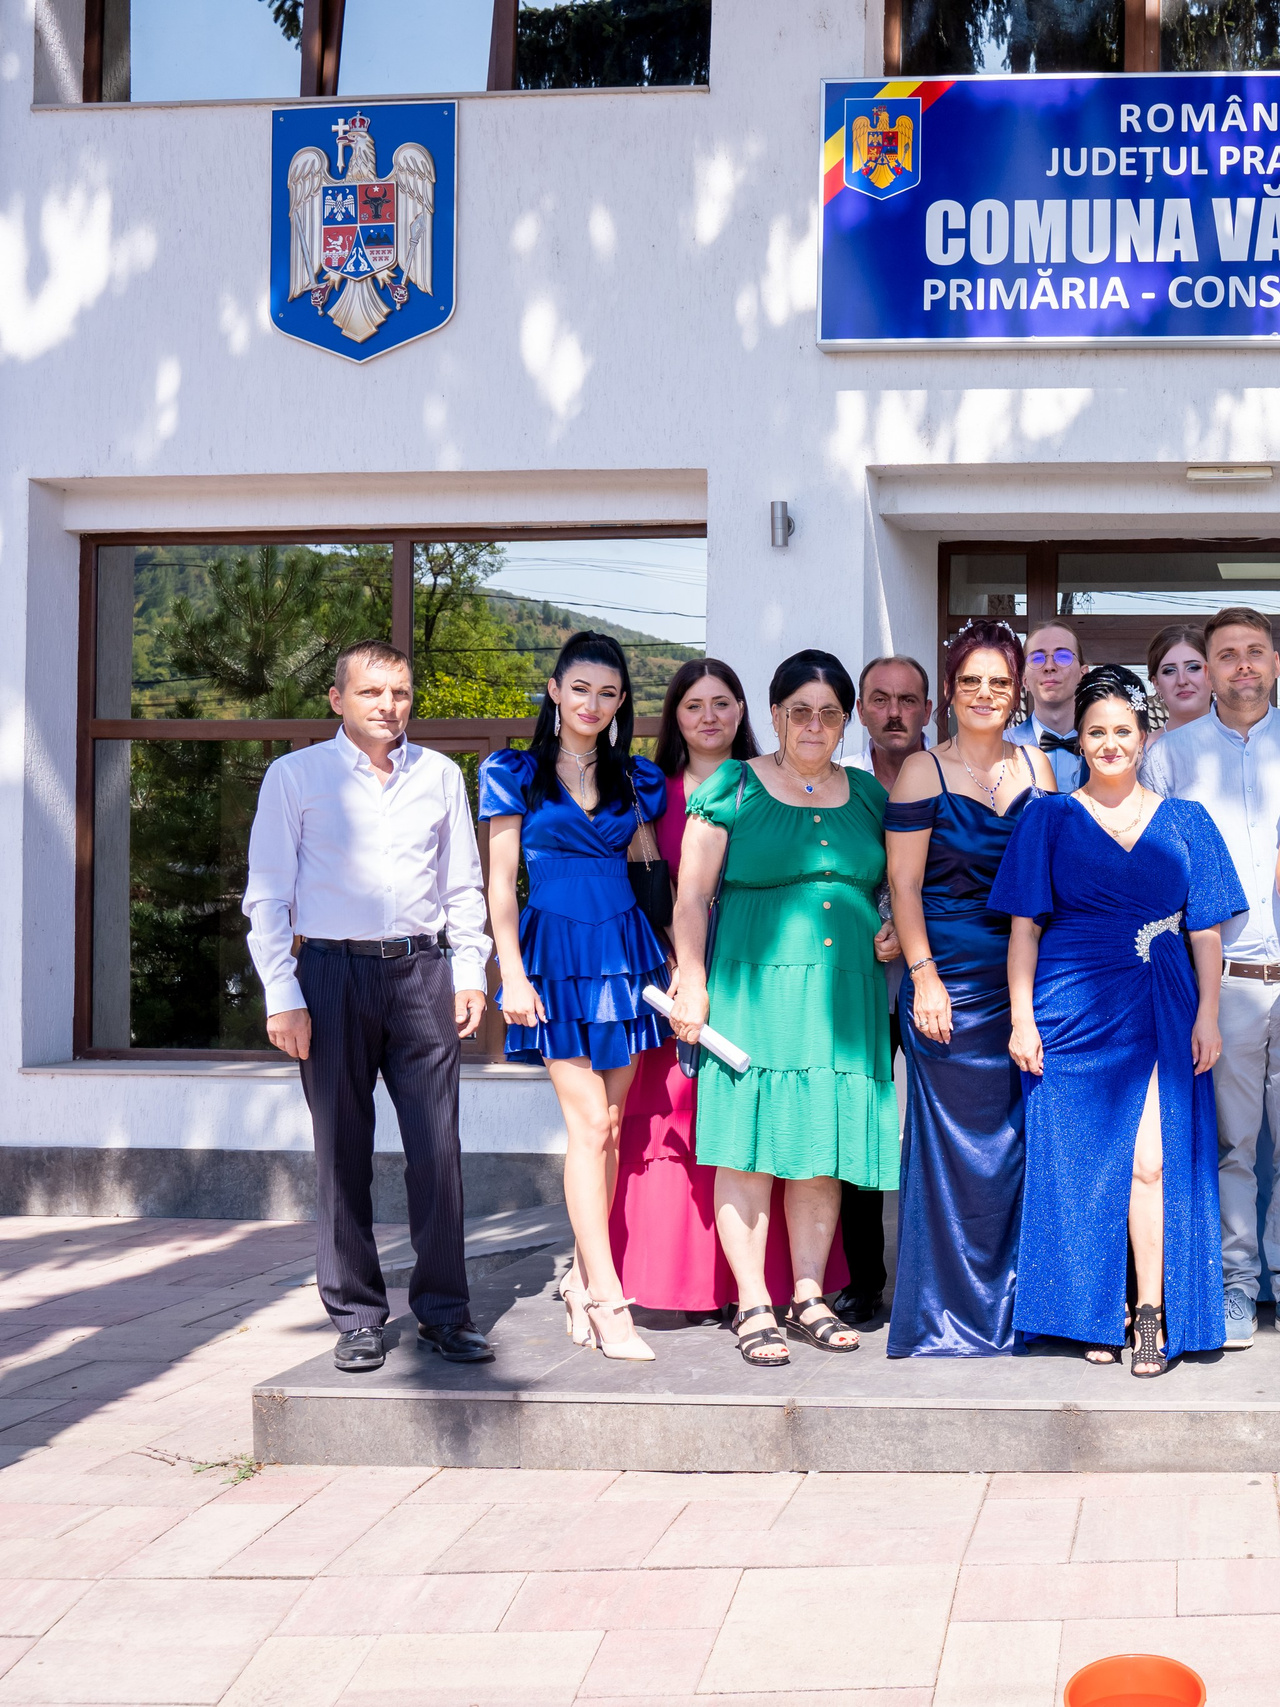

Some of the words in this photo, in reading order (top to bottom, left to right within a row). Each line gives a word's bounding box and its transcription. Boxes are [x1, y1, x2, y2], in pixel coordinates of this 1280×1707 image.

[1045, 146, 1209, 183] JUDEȚUL
[925, 197, 1199, 266] COMUNA
[923, 267, 1131, 311] PRIMĂRIA
